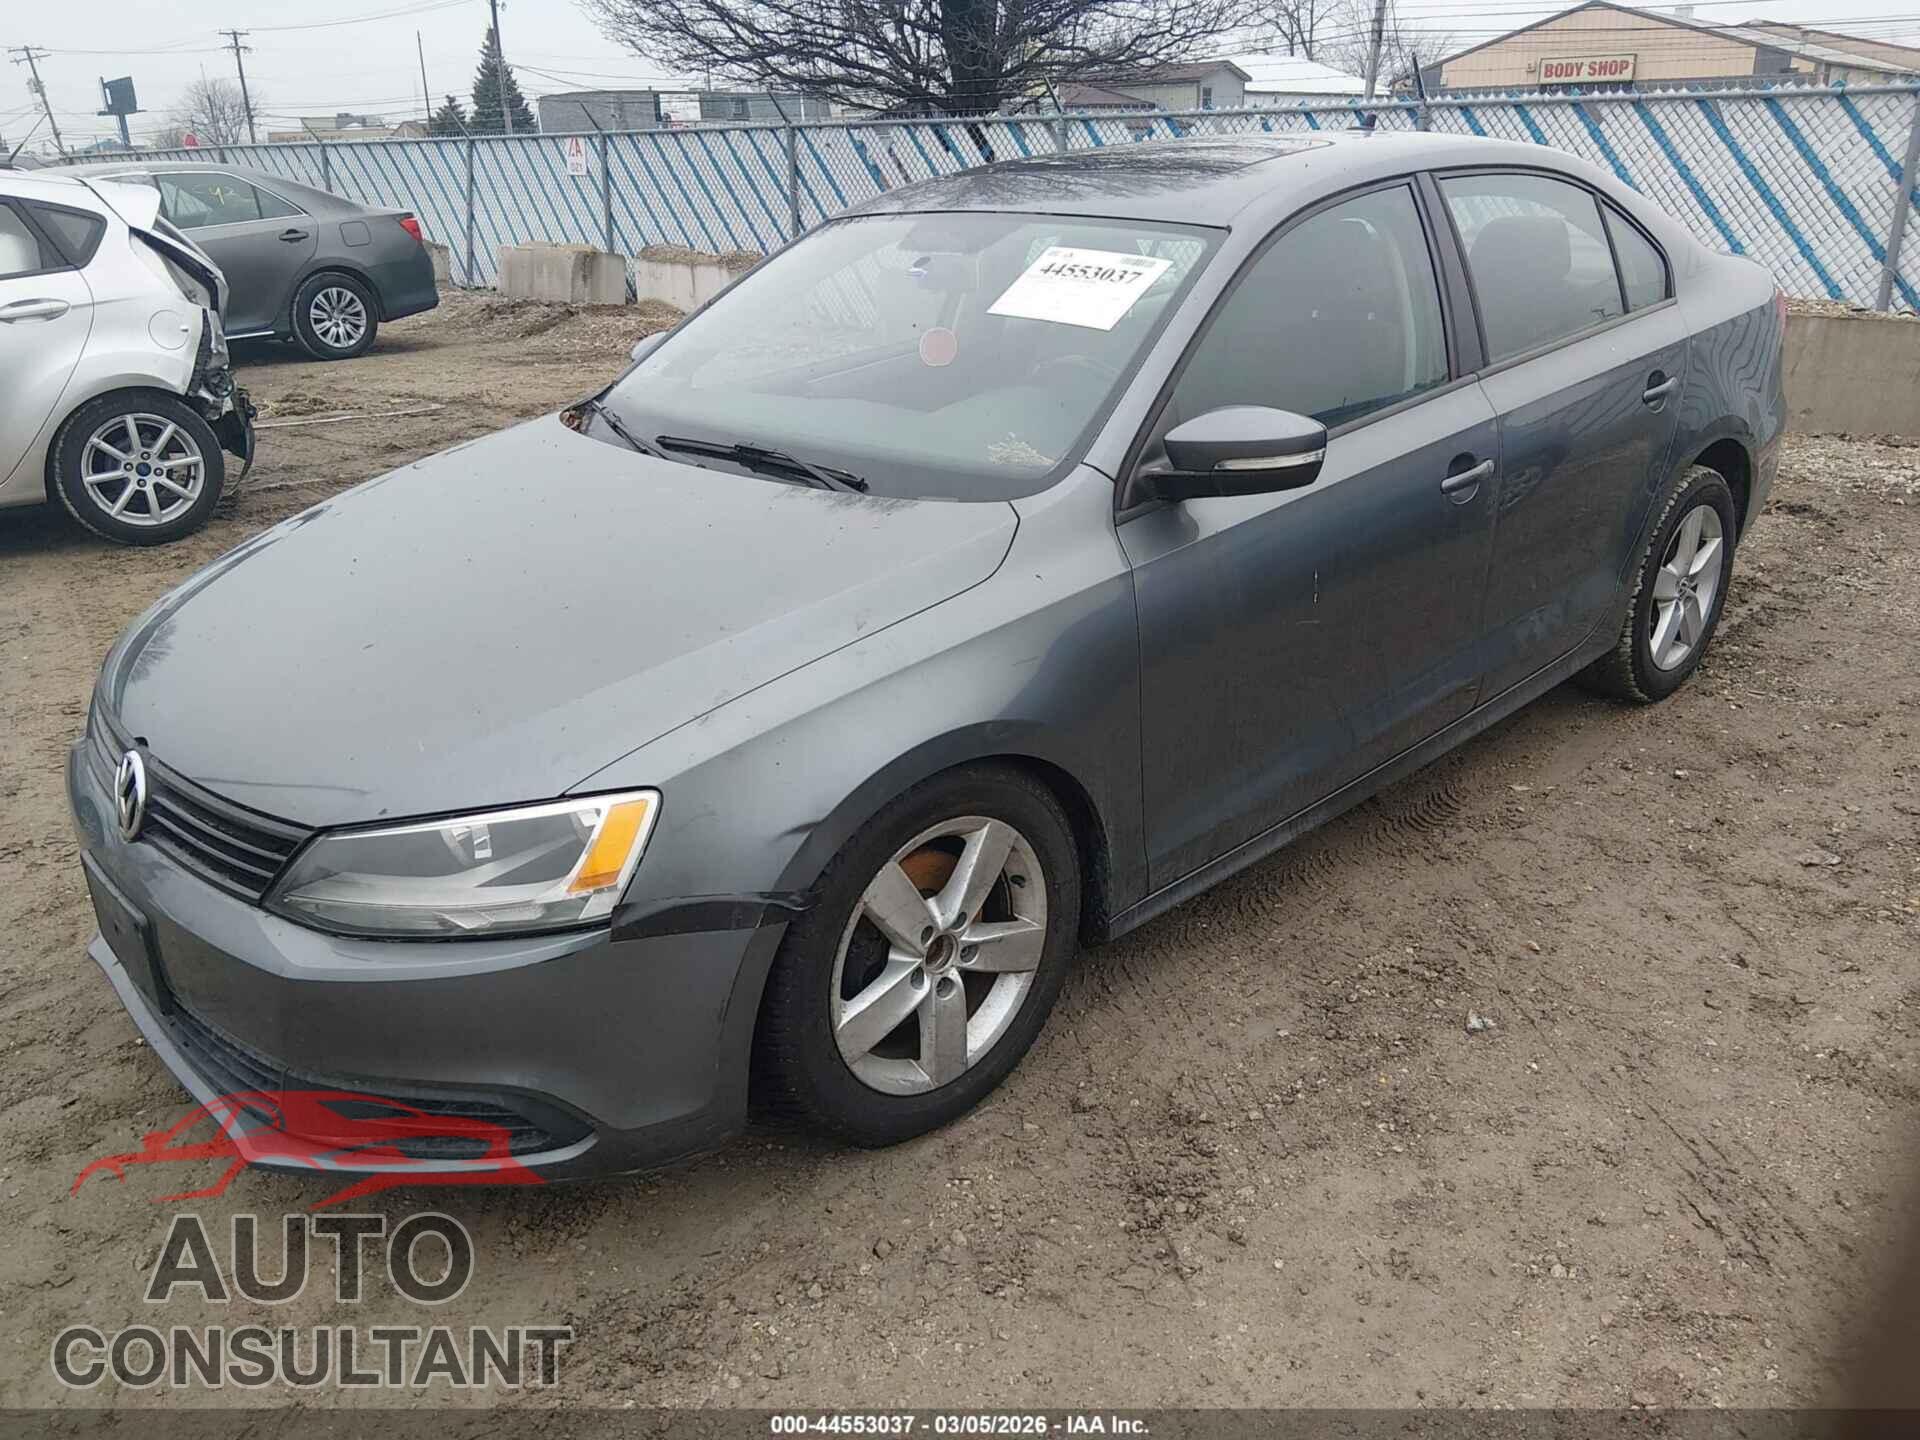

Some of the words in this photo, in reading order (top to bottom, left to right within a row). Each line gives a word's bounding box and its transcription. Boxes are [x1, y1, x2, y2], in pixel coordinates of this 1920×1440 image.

[1543, 61, 1584, 78] BODY
[1587, 60, 1630, 76] SHOP
[1040, 262, 1143, 285] 44553037
